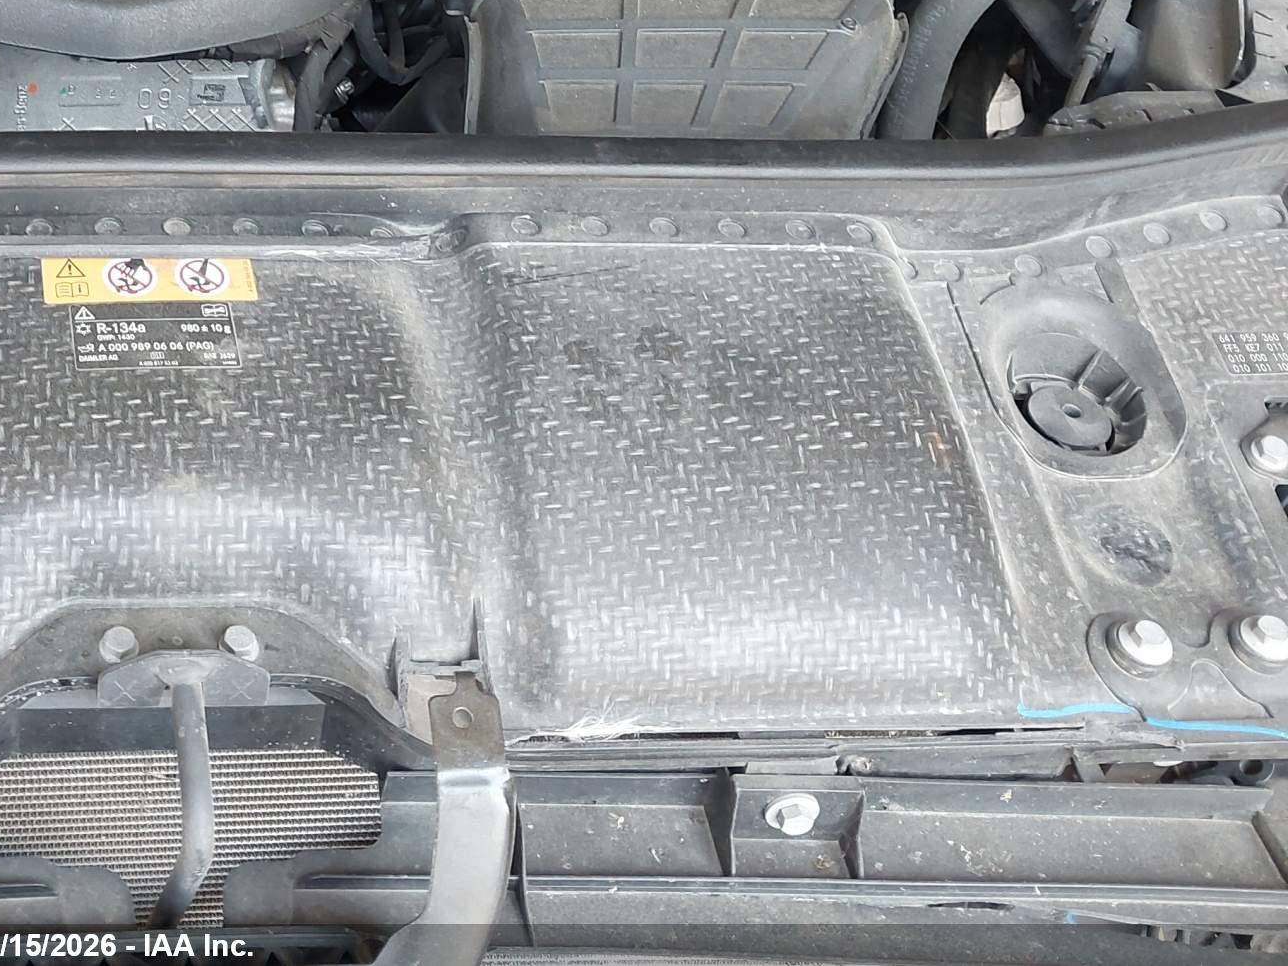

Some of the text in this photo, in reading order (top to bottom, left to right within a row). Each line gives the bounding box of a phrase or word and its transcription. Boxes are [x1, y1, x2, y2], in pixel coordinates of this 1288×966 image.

[96, 322, 146, 334] R-134a
[180, 323, 200, 333] 980
[210, 323, 223, 332] 10
[1219, 334, 1236, 343] 641
[1239, 333, 1257, 342] 959
[98, 340, 215, 352] A 000 989 06 06 (PAG)
[1265, 342, 1285, 352] 011
[1227, 353, 1246, 362] 010
[1249, 353, 1268, 362] 000
[1232, 364, 1251, 373] 010
[1255, 363, 1273, 372] 101
